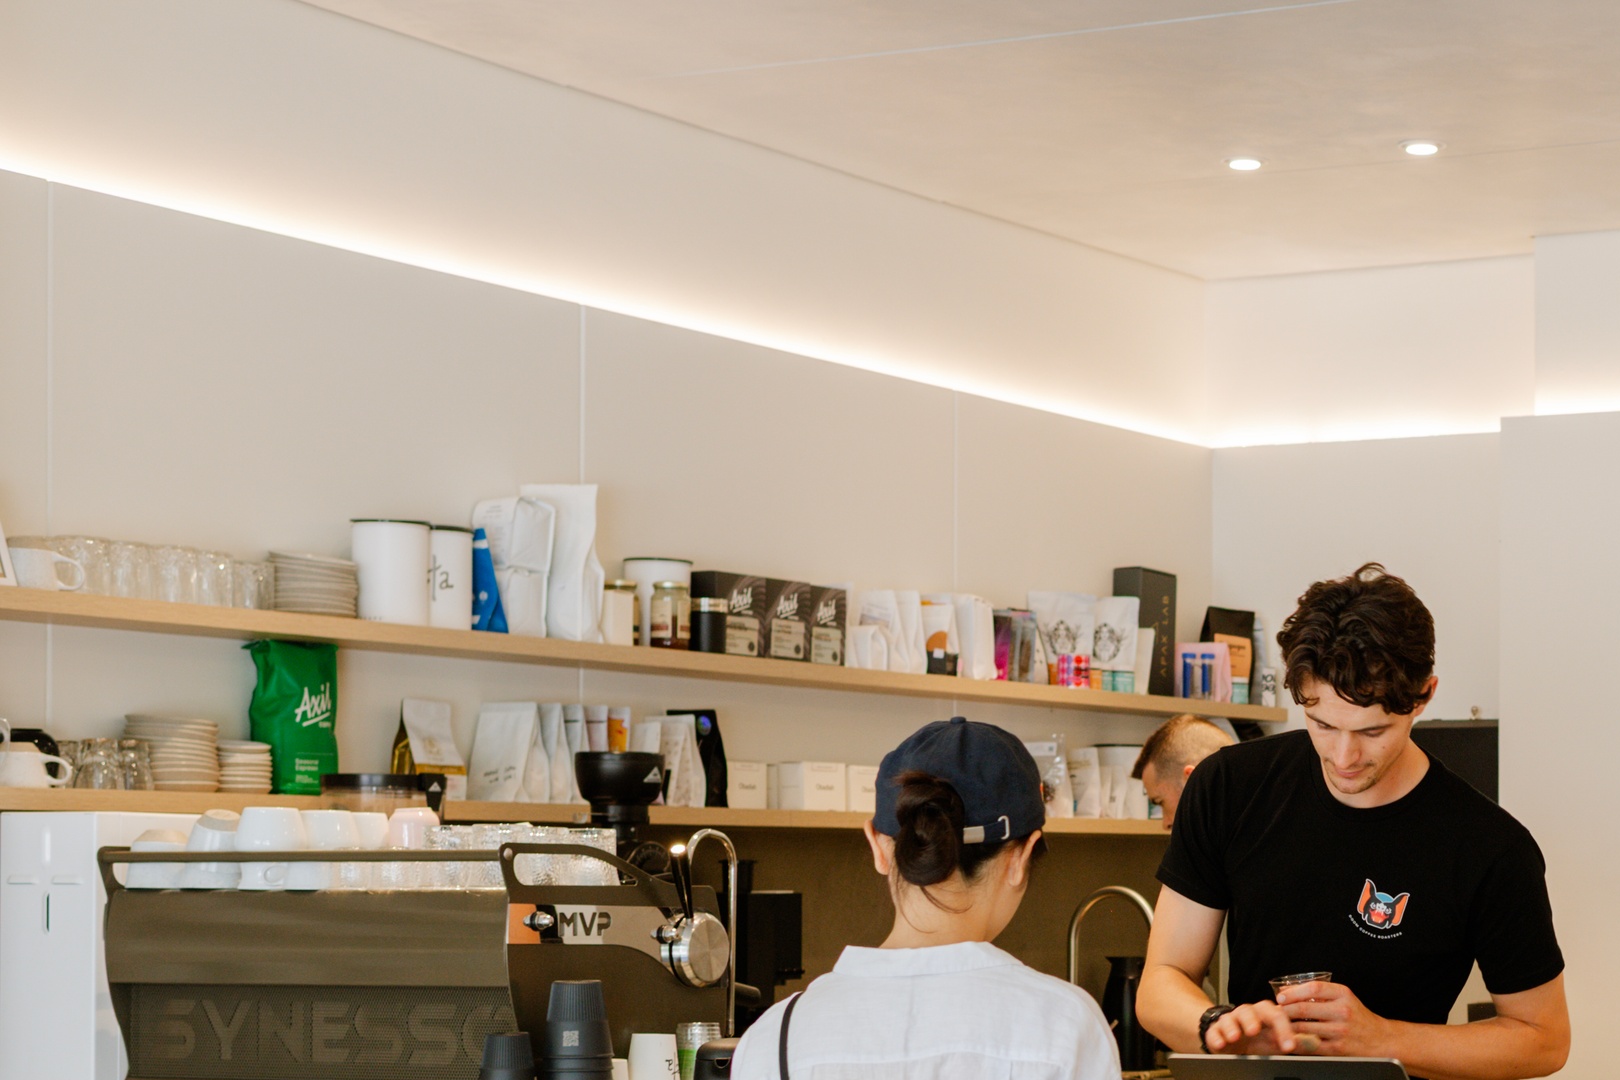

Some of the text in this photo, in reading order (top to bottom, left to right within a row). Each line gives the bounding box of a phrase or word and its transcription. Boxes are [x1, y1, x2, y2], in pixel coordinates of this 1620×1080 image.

[1160, 595, 1170, 677] APAX LAB
[294, 682, 332, 723] Axil
[558, 911, 612, 938] MVP
[1359, 926, 1377, 938] COFFEE
[1377, 931, 1403, 939] ROASTERS
